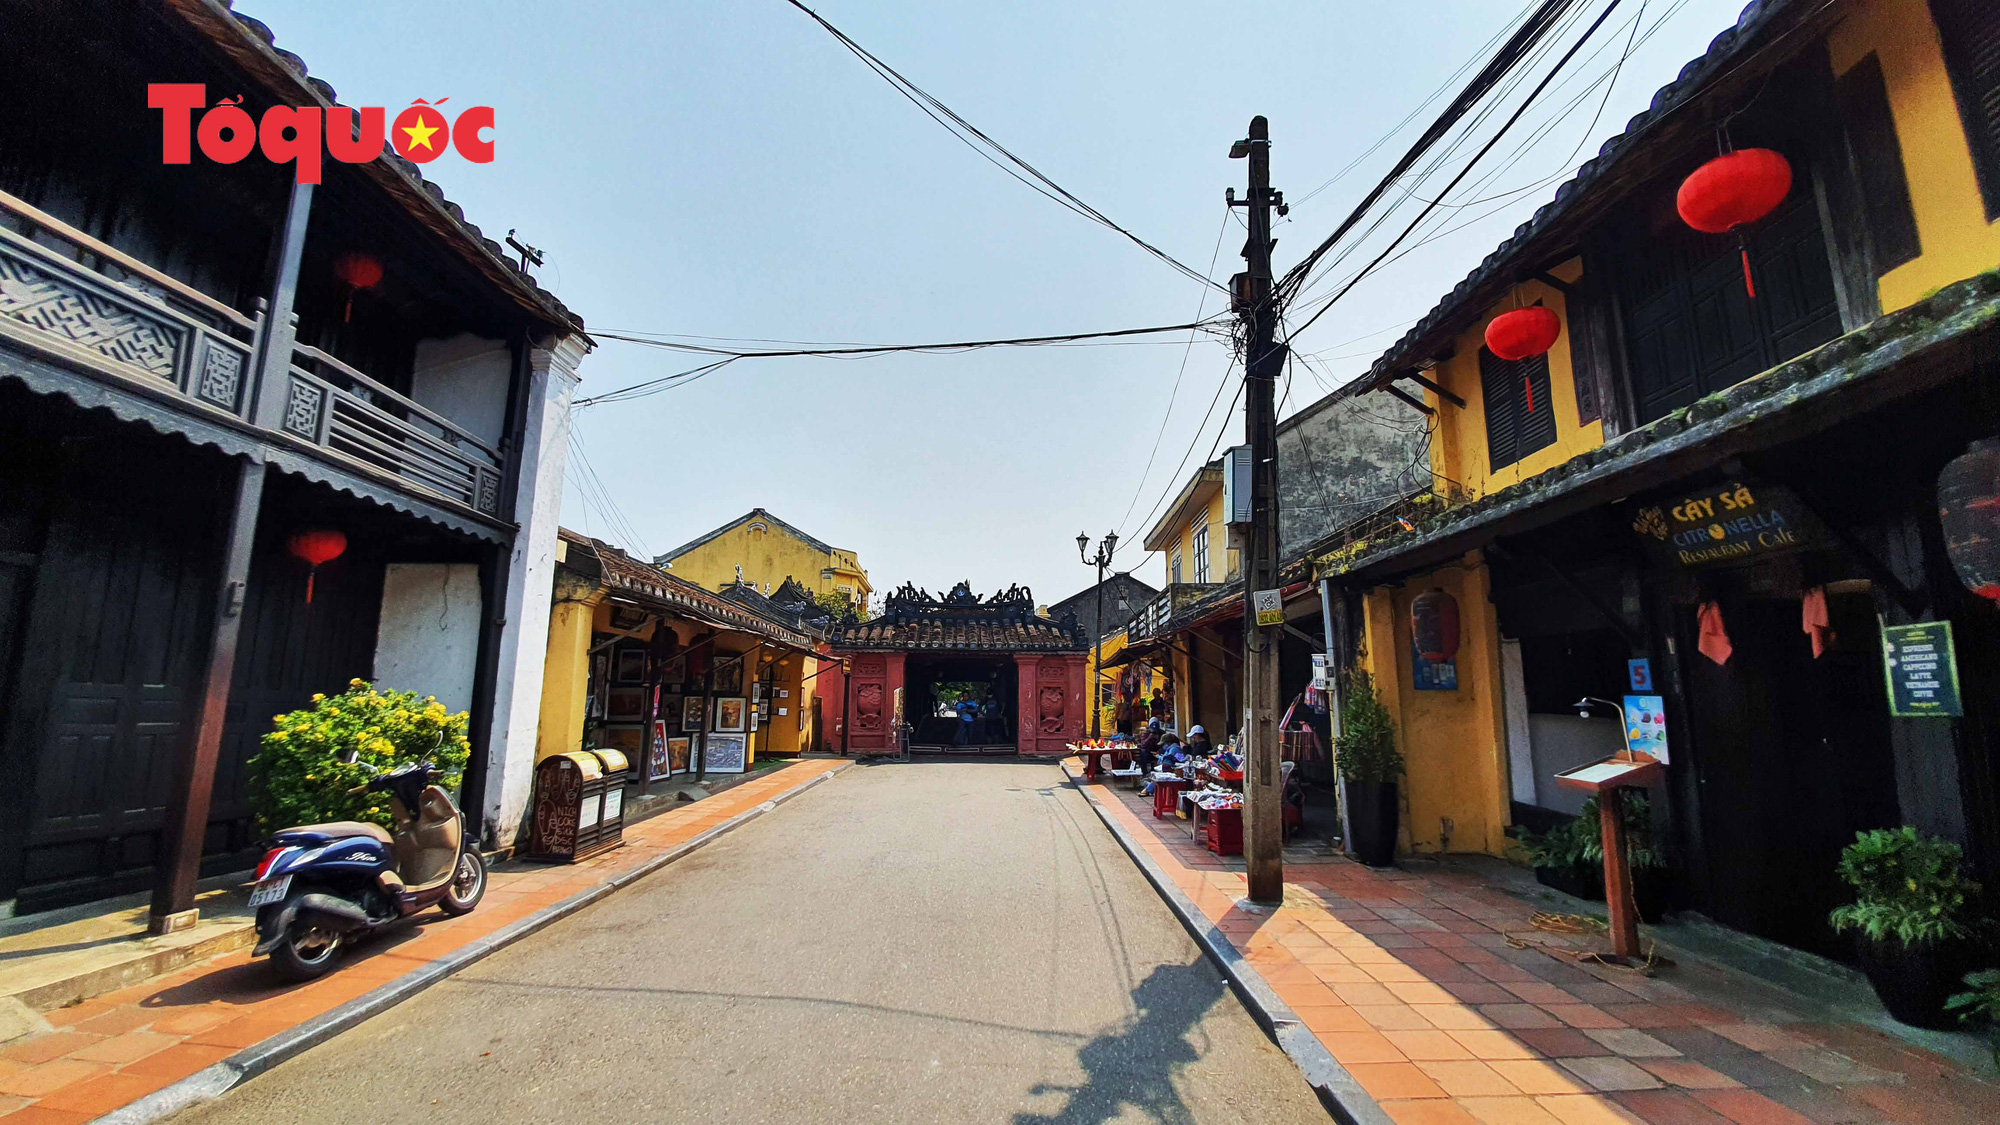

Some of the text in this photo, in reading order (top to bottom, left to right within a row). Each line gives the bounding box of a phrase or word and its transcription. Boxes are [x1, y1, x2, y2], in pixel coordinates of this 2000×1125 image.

[1672, 483, 1755, 521] CÂY SẢ
[1673, 509, 1785, 546] CITRONELLA
[1633, 665, 1646, 686] 5
[1910, 672, 1932, 680] LATTE
